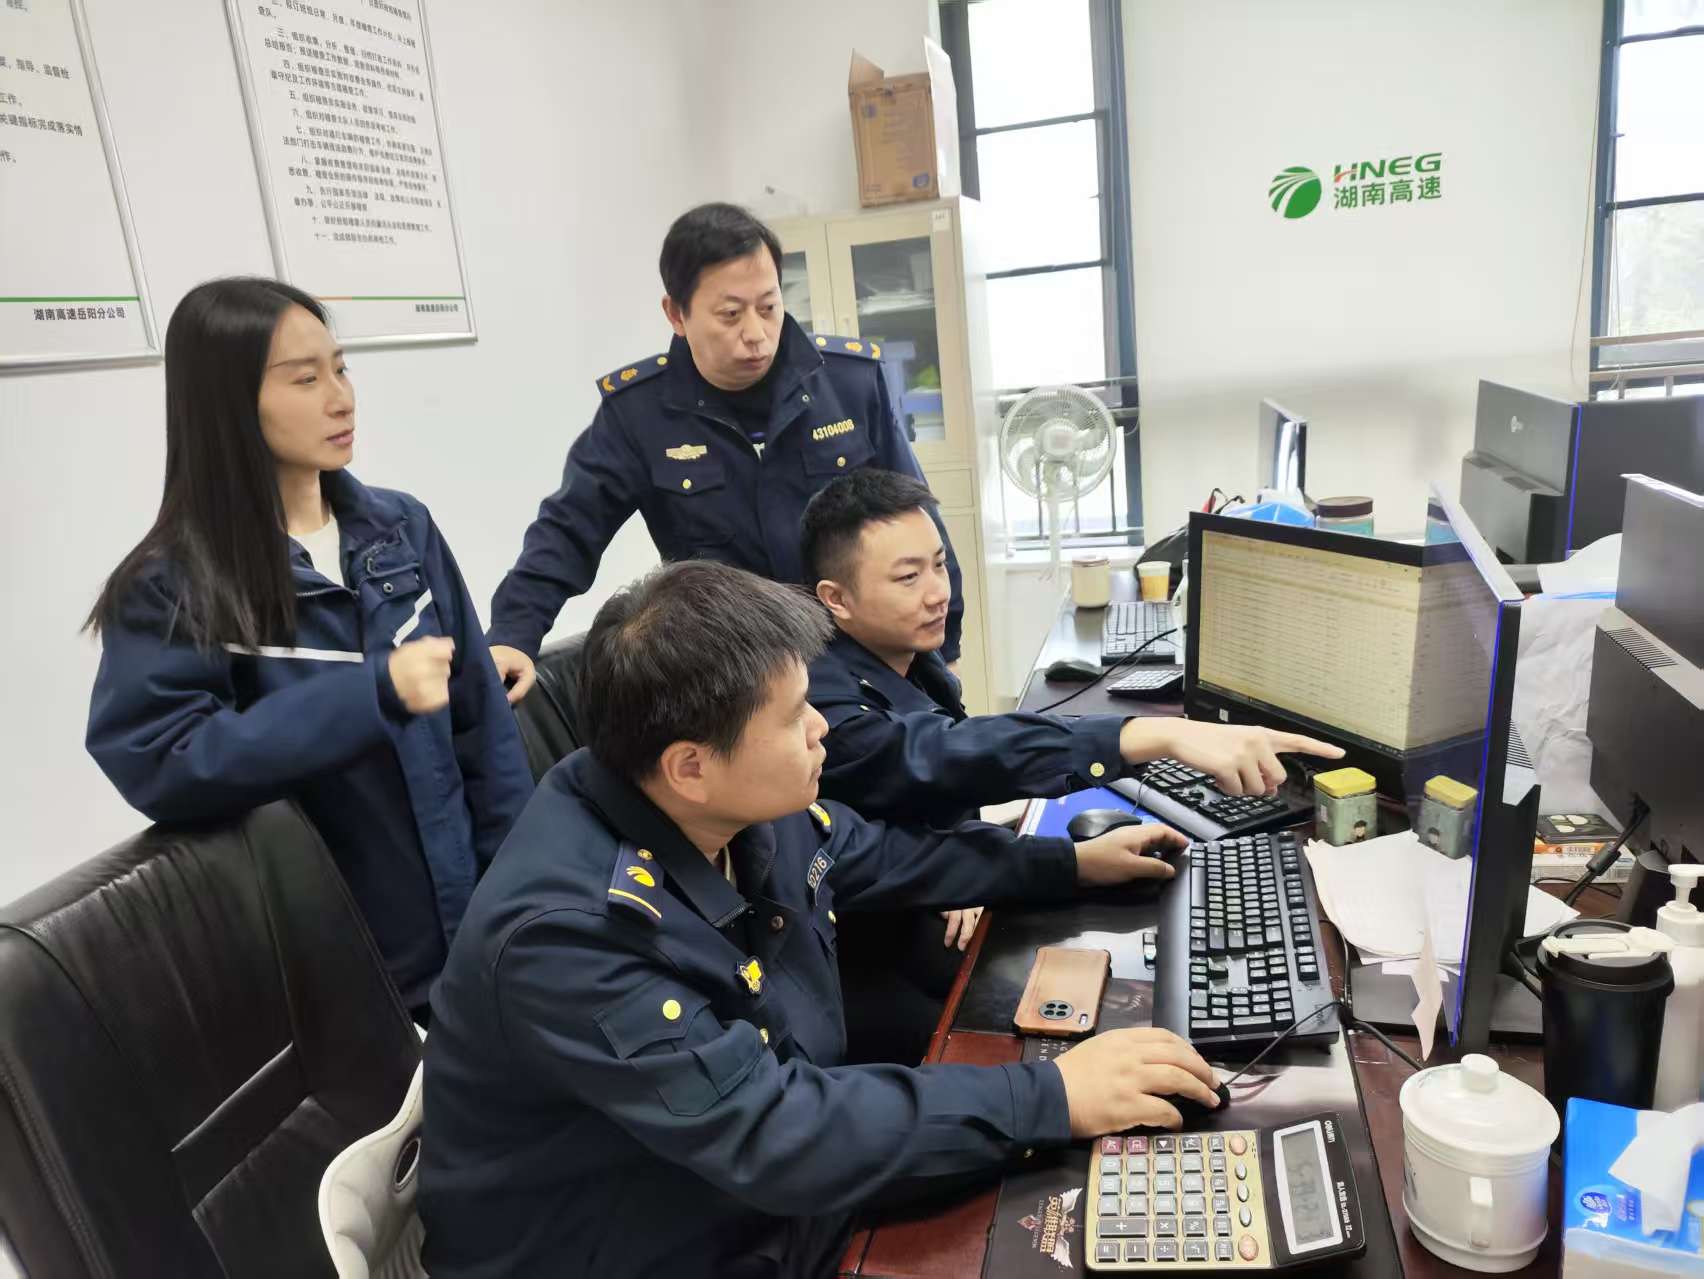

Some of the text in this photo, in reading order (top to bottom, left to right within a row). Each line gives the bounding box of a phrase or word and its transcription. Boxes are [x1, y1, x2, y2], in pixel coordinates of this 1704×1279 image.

[1334, 153, 1442, 183] HNEG
[1334, 176, 1442, 210] 湖南高速
[34, 307, 125, 320] 湖南高速岳阳分公司
[1040, 1196, 1062, 1253] 英雄联盟
